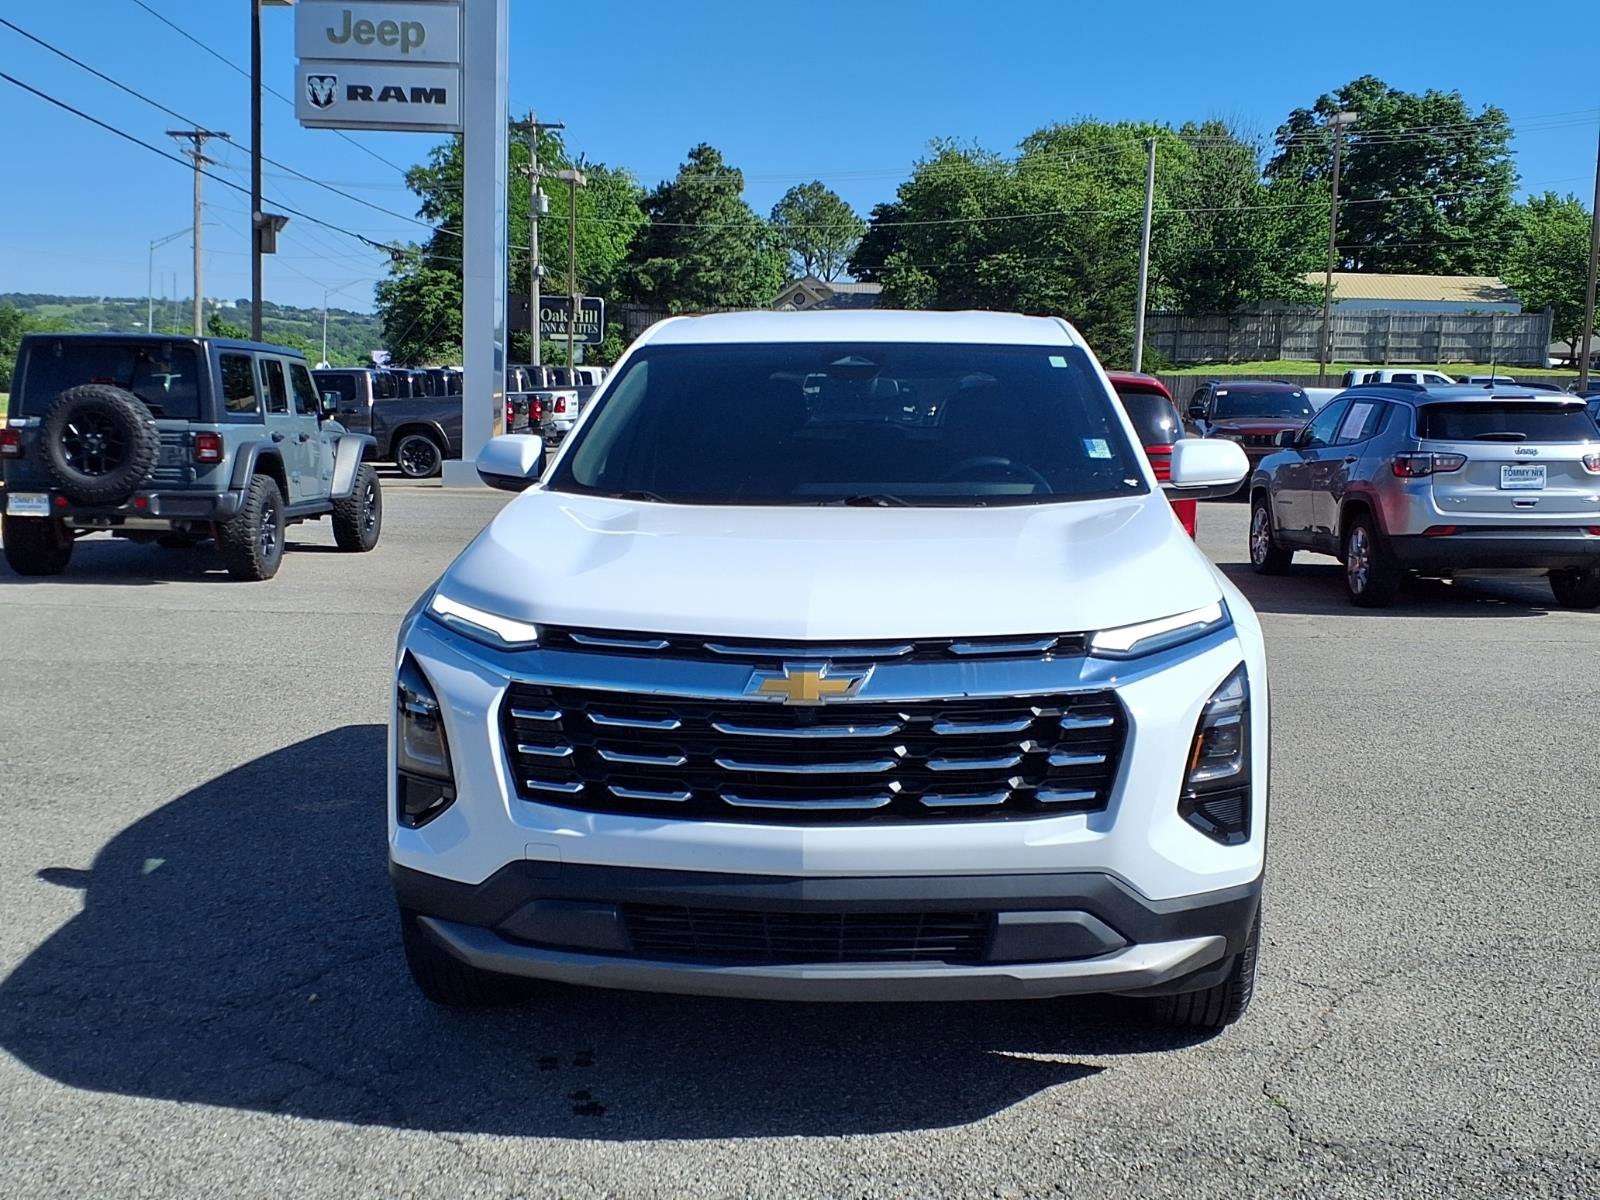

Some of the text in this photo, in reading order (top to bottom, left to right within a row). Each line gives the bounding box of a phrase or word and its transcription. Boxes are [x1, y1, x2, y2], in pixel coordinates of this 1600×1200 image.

[326, 9, 426, 54] Jeep
[346, 84, 447, 105] RAM
[540, 308, 598, 323] Oak Hill
[540, 322, 599, 334] INN & UITES
[1503, 469, 1544, 478] TOMMY NIX
